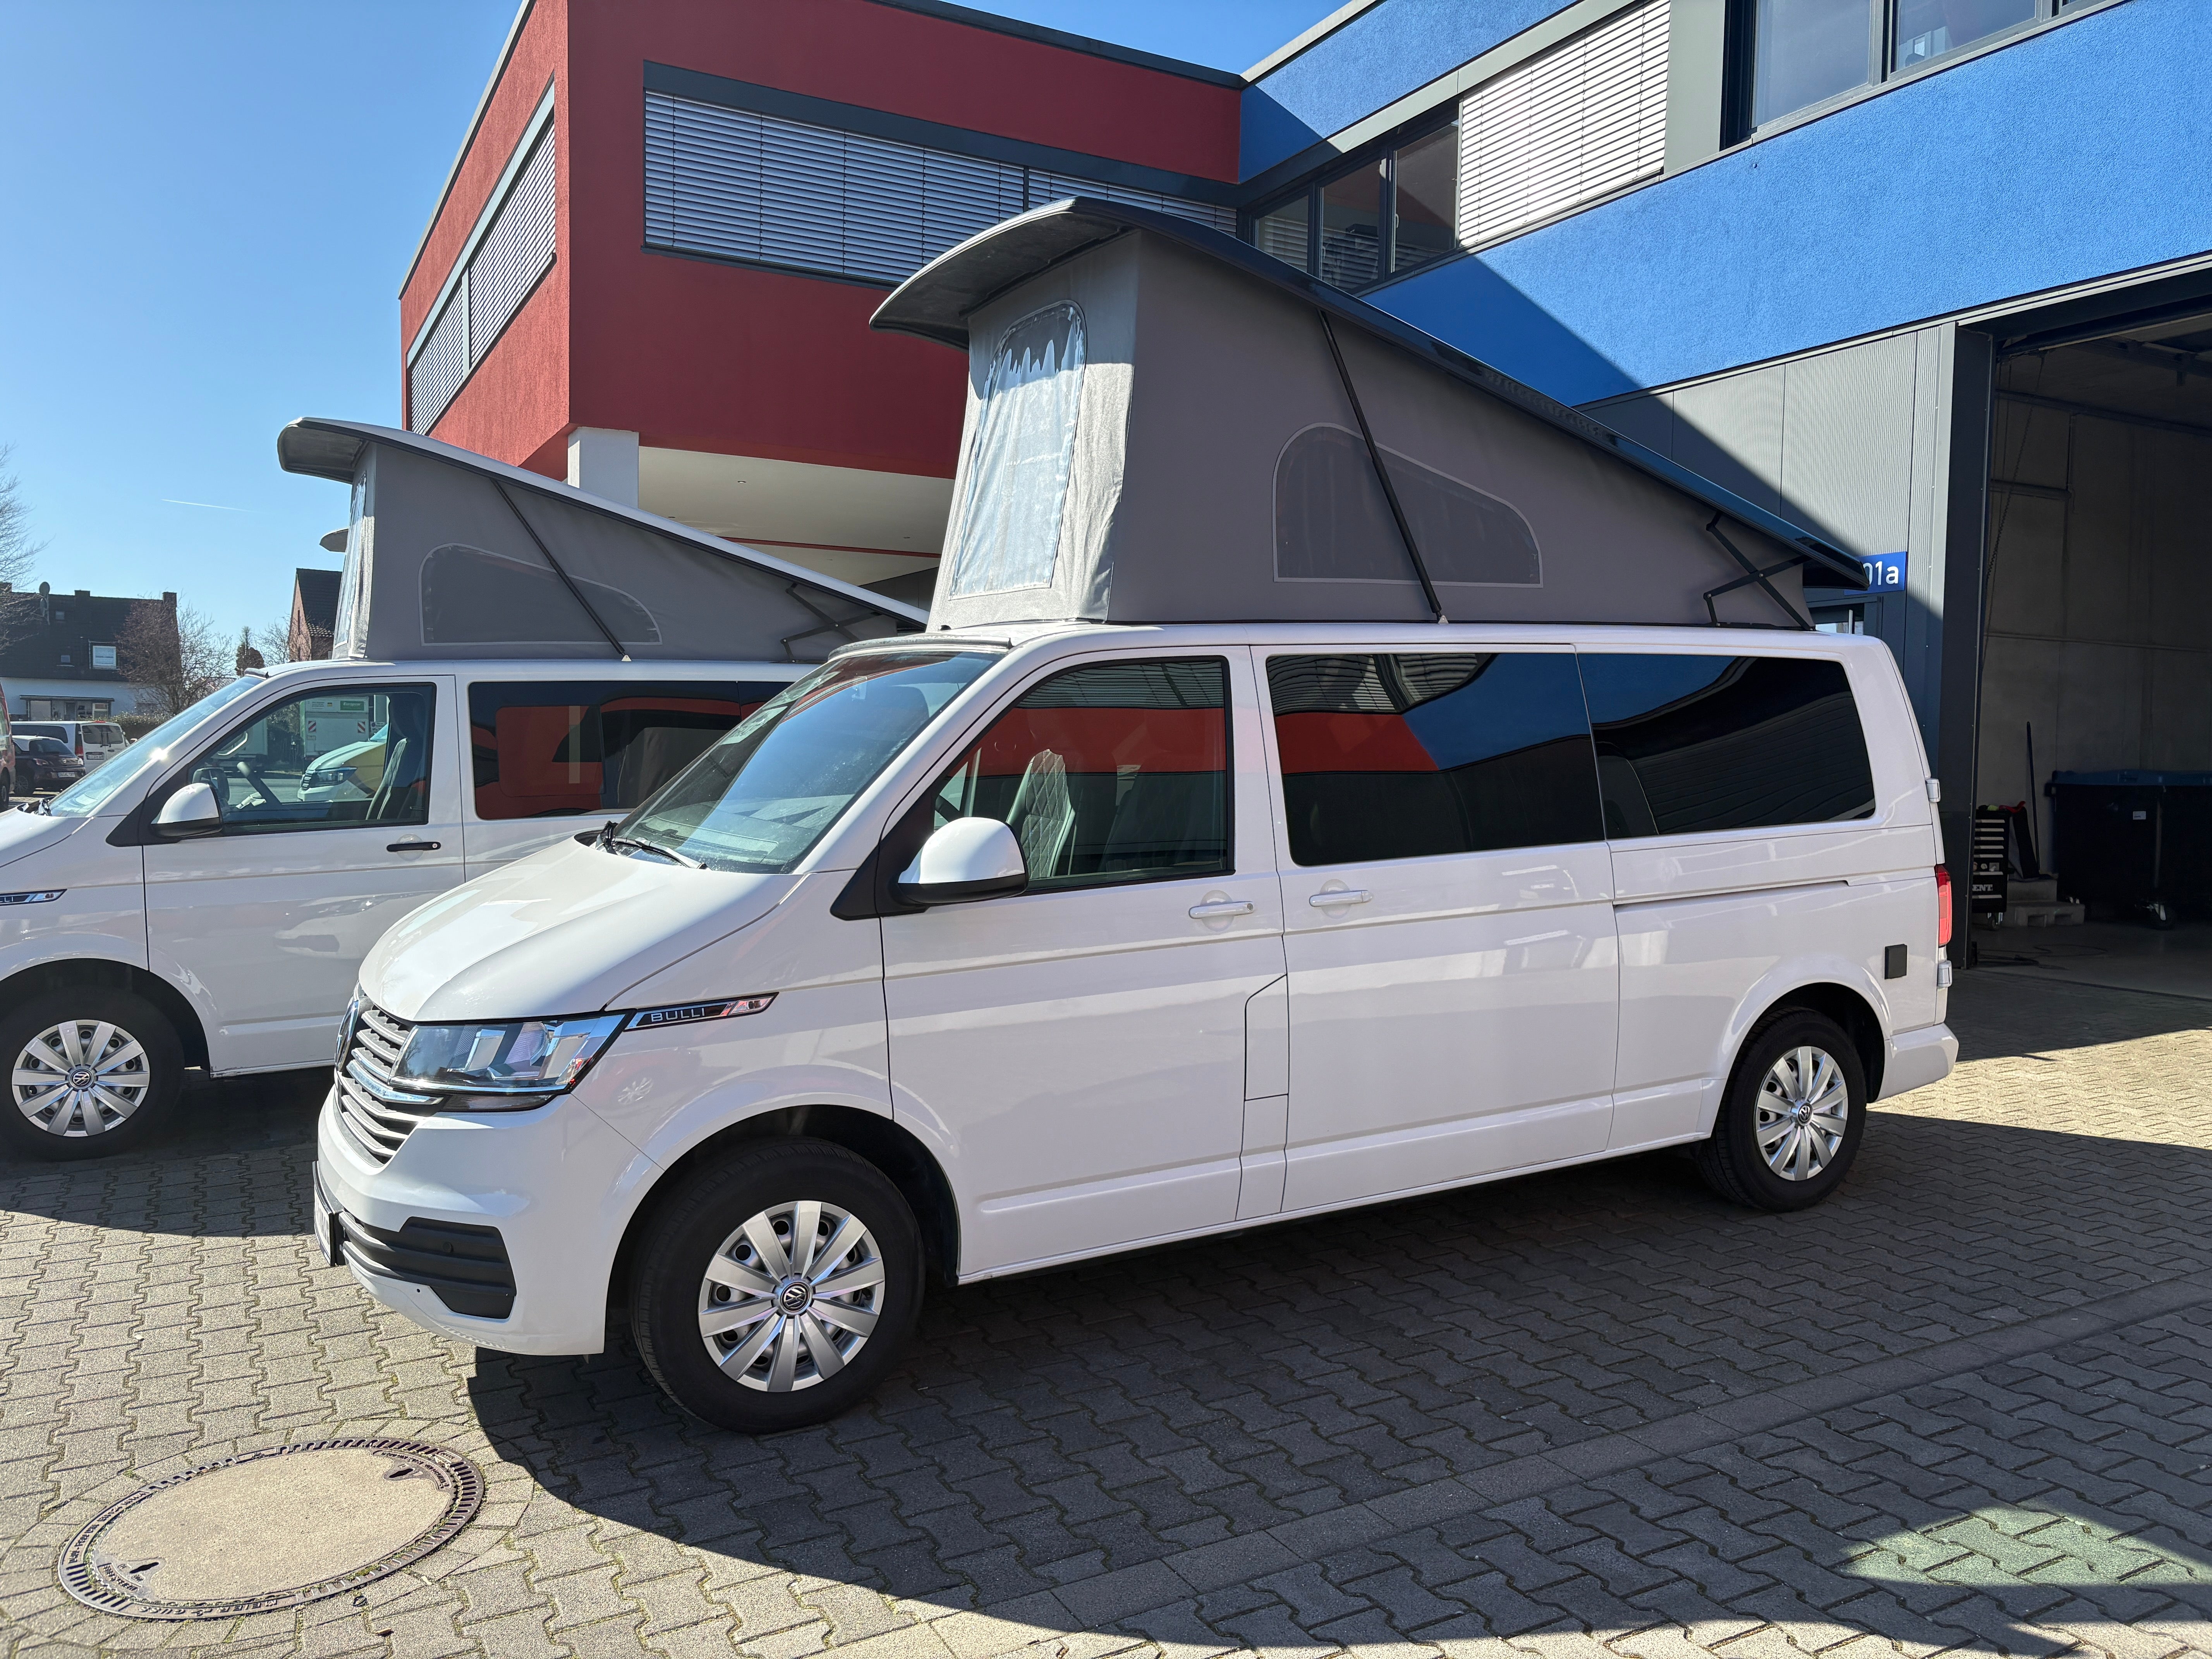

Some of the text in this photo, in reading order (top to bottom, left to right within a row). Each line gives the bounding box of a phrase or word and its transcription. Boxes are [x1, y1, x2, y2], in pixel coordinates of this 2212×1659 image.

[651, 1008, 705, 1022] BULLI
[139, 1600, 277, 1614] MEIER GUSS
